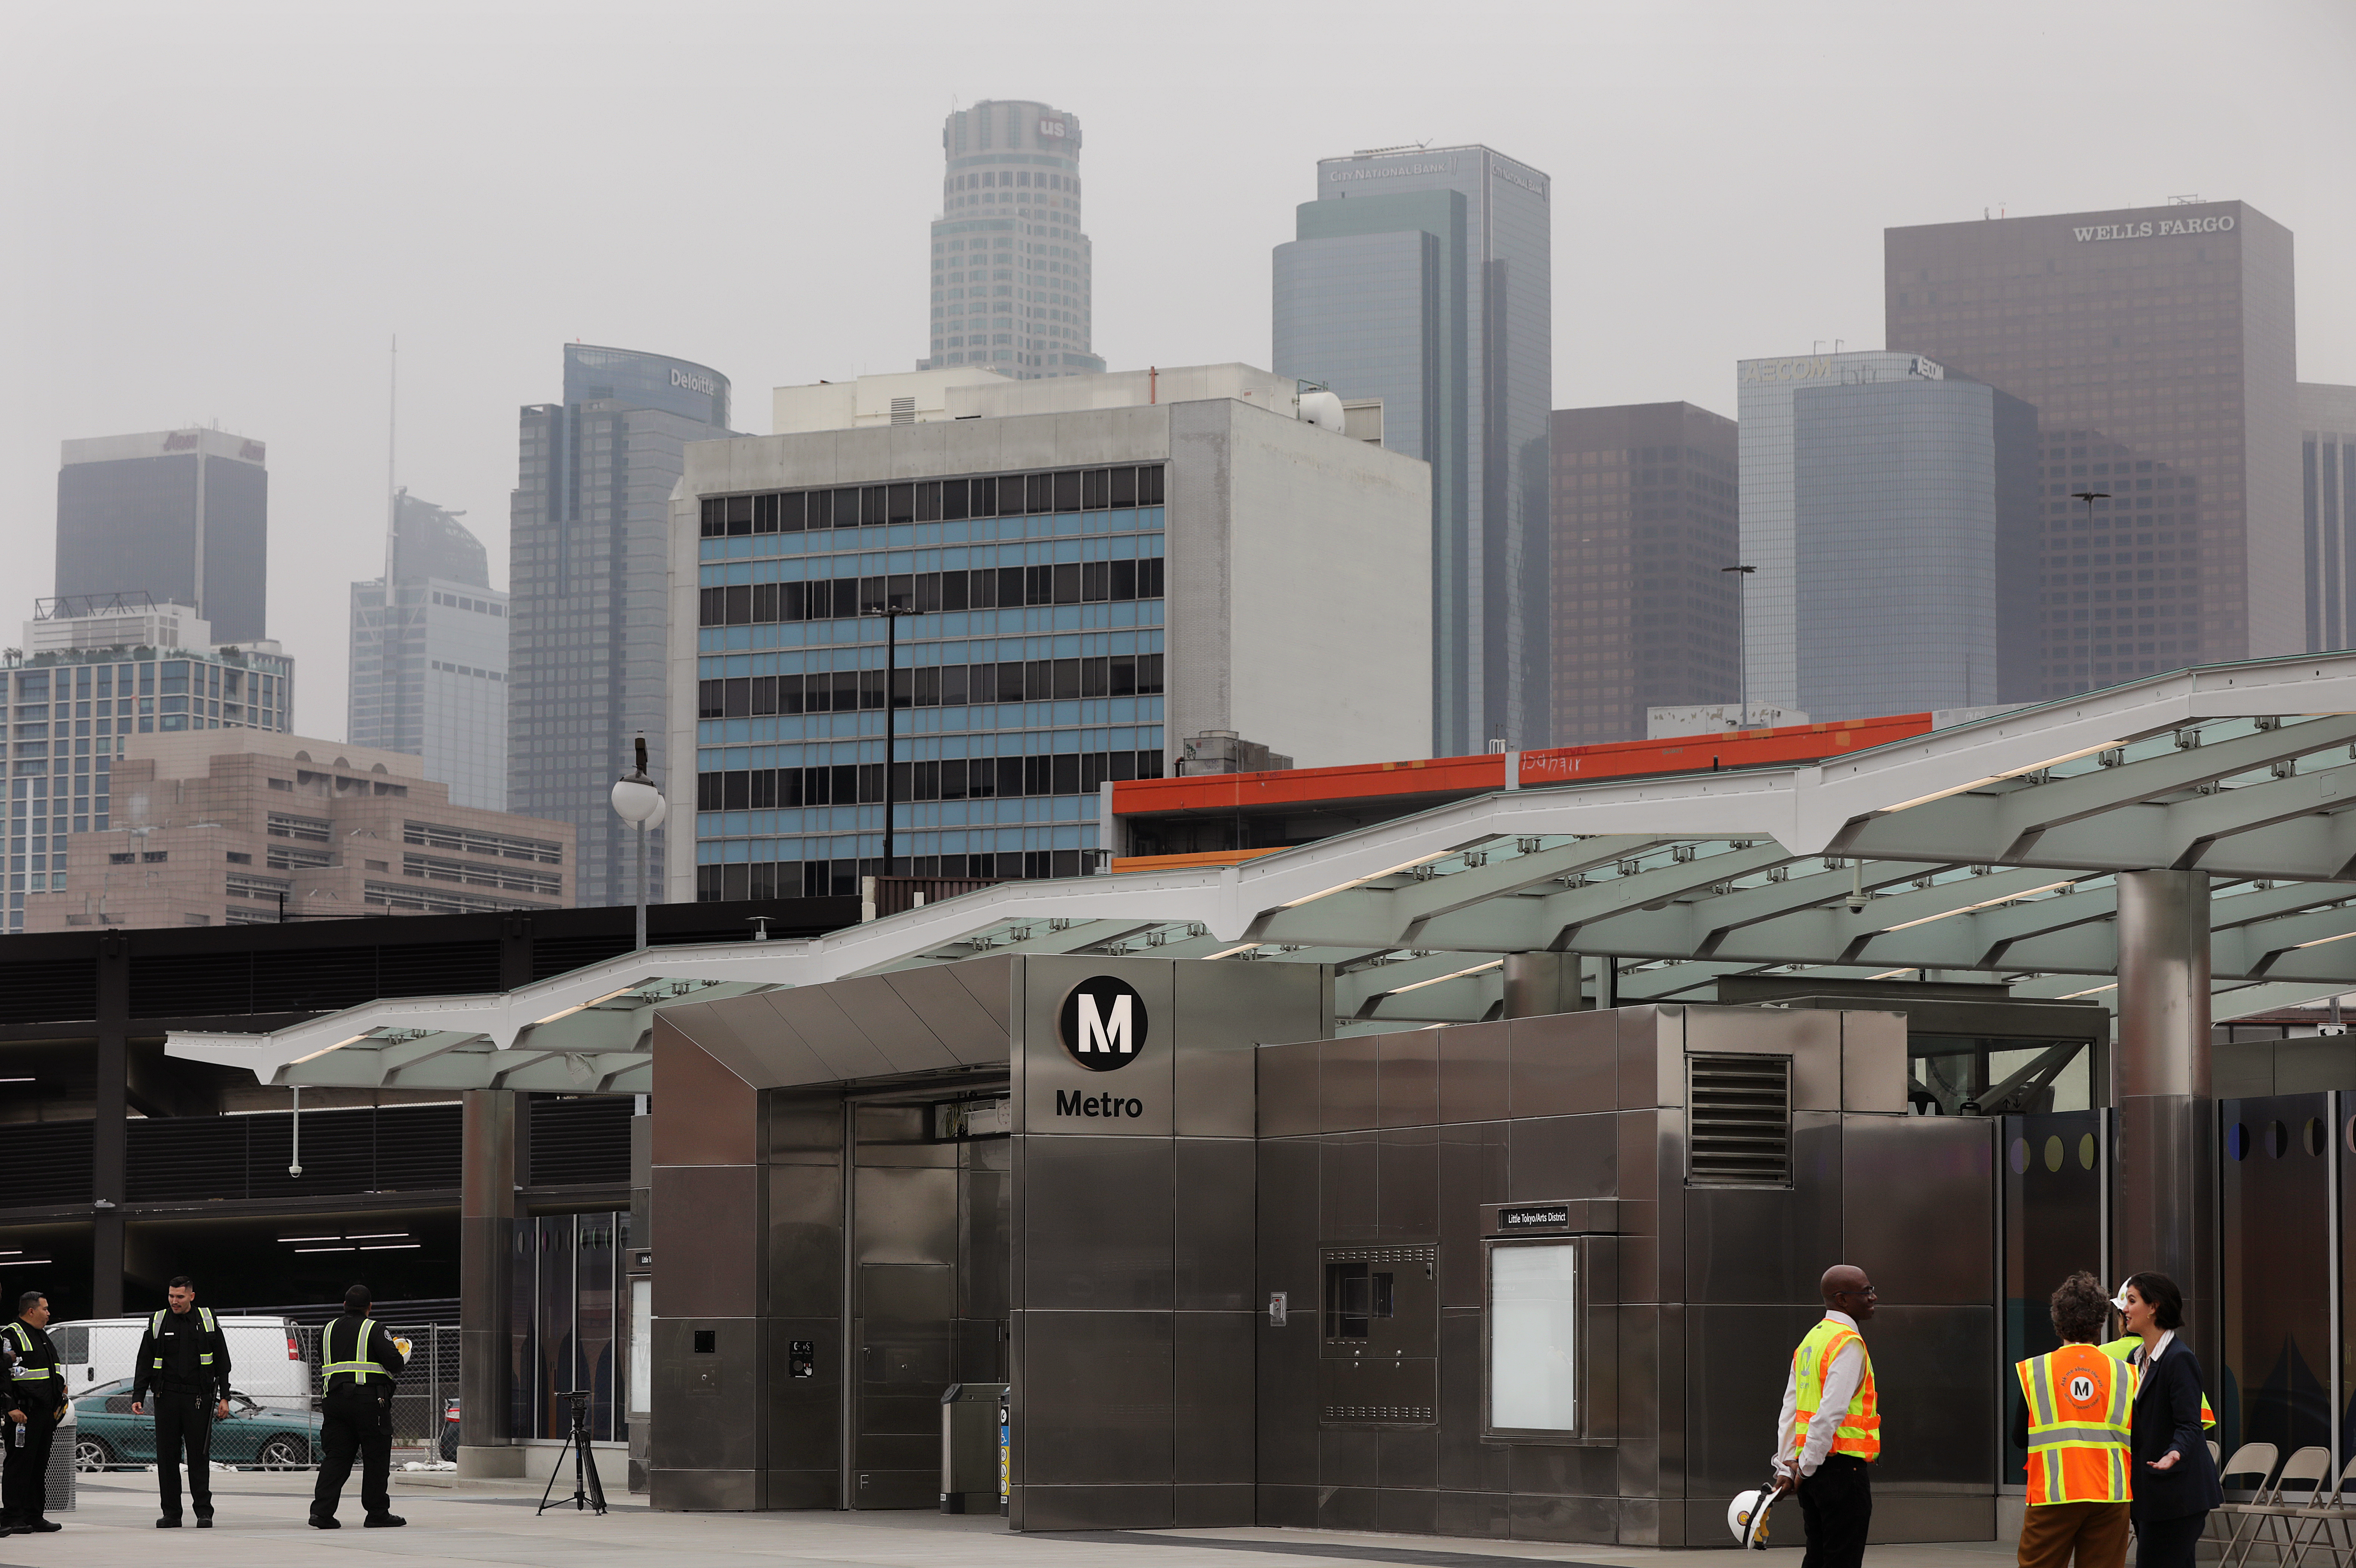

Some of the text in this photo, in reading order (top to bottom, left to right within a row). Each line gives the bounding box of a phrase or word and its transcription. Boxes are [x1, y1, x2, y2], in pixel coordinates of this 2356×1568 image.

[1355, 167, 1412, 181] NATIONAL
[1413, 163, 1446, 175] BANK
[2073, 216, 2234, 242] WELLS FARGO
[670, 368, 714, 396] Deloitte
[1742, 357, 1832, 383] AECOM
[1078, 994, 1132, 1053] M
[1056, 1090, 1143, 1118] Metro
[1508, 1212, 1566, 1225] Little Tokyo/Arts District
[2075, 1381, 2089, 1396] M
